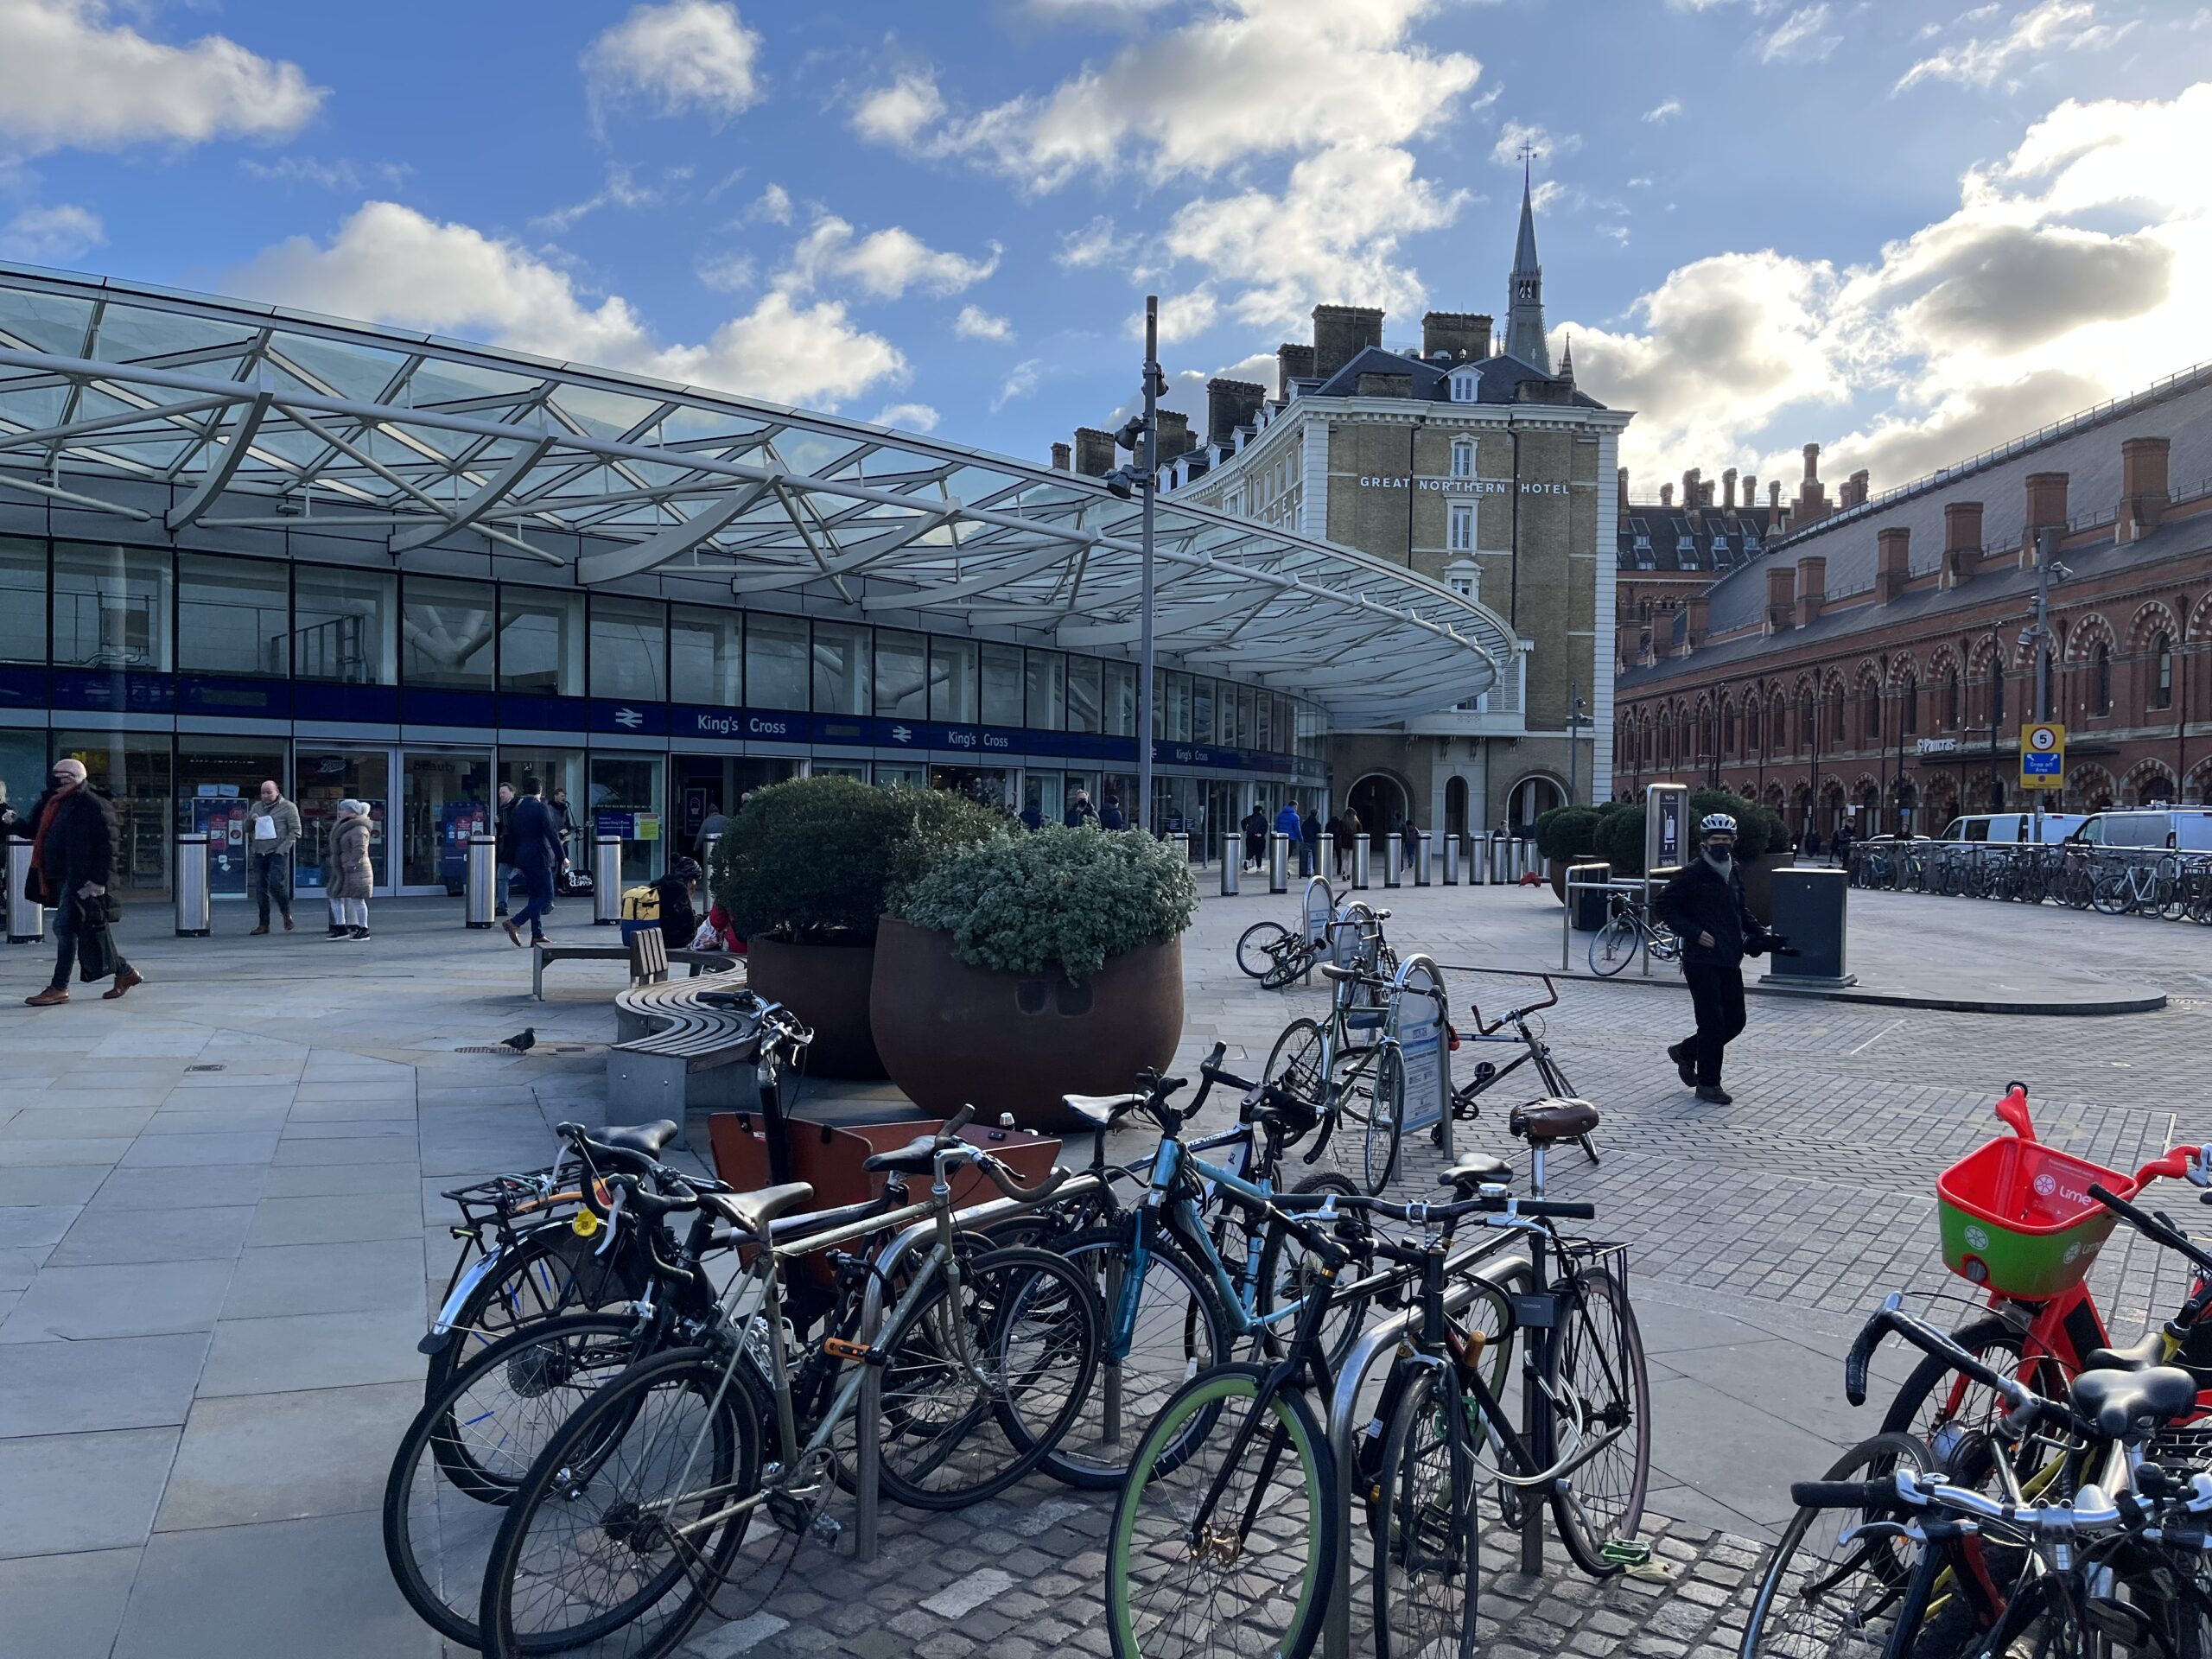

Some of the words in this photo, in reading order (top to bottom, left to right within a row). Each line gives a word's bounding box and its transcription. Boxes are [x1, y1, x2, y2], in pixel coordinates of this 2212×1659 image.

[1359, 477, 1410, 488] GREAT
[1419, 480, 1505, 493] NORTHERN
[1521, 483, 1570, 494] HOTEL
[1262, 489, 1299, 524] OTEL
[697, 715, 739, 734] King's
[749, 717, 787, 734] Cross
[948, 730, 976, 747] King's
[983, 734, 1009, 747] Cross
[2039, 734, 2048, 744] 5
[1175, 748, 1192, 762] King's
[1194, 750, 1209, 761] Cross
[2059, 1185, 2092, 1205] Lime
